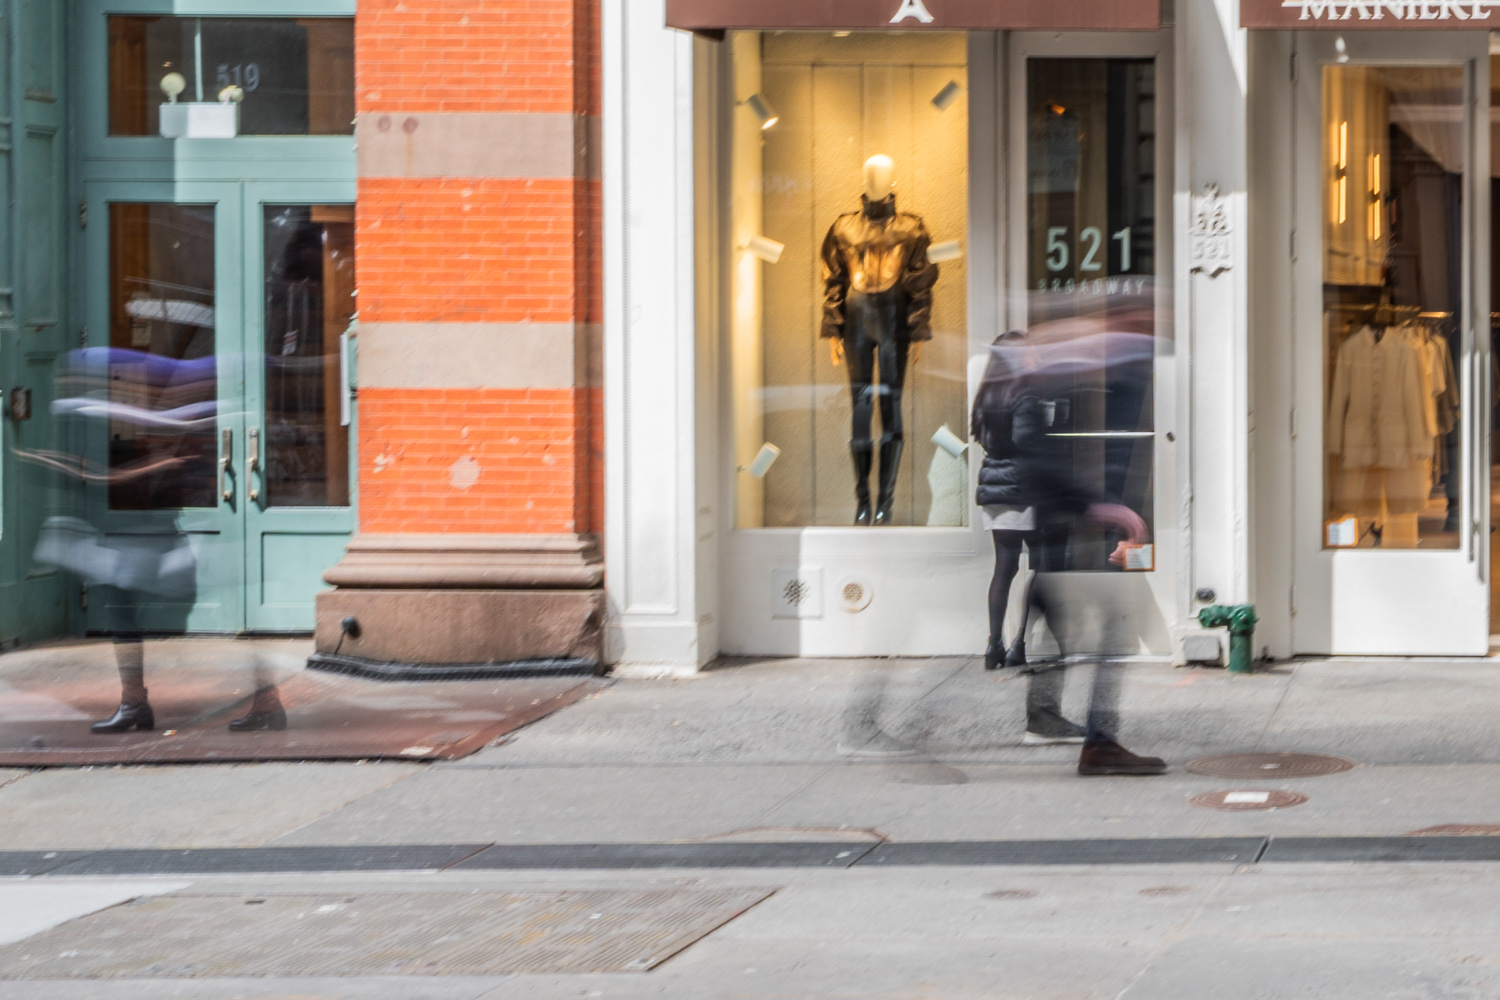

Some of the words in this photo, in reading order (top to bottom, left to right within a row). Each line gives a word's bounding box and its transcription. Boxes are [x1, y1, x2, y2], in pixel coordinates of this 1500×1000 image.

[216, 62, 260, 93] 519
[1046, 226, 1132, 272] 521
[1192, 240, 1231, 260] 521
[1038, 278, 1145, 296] BROADWAY
